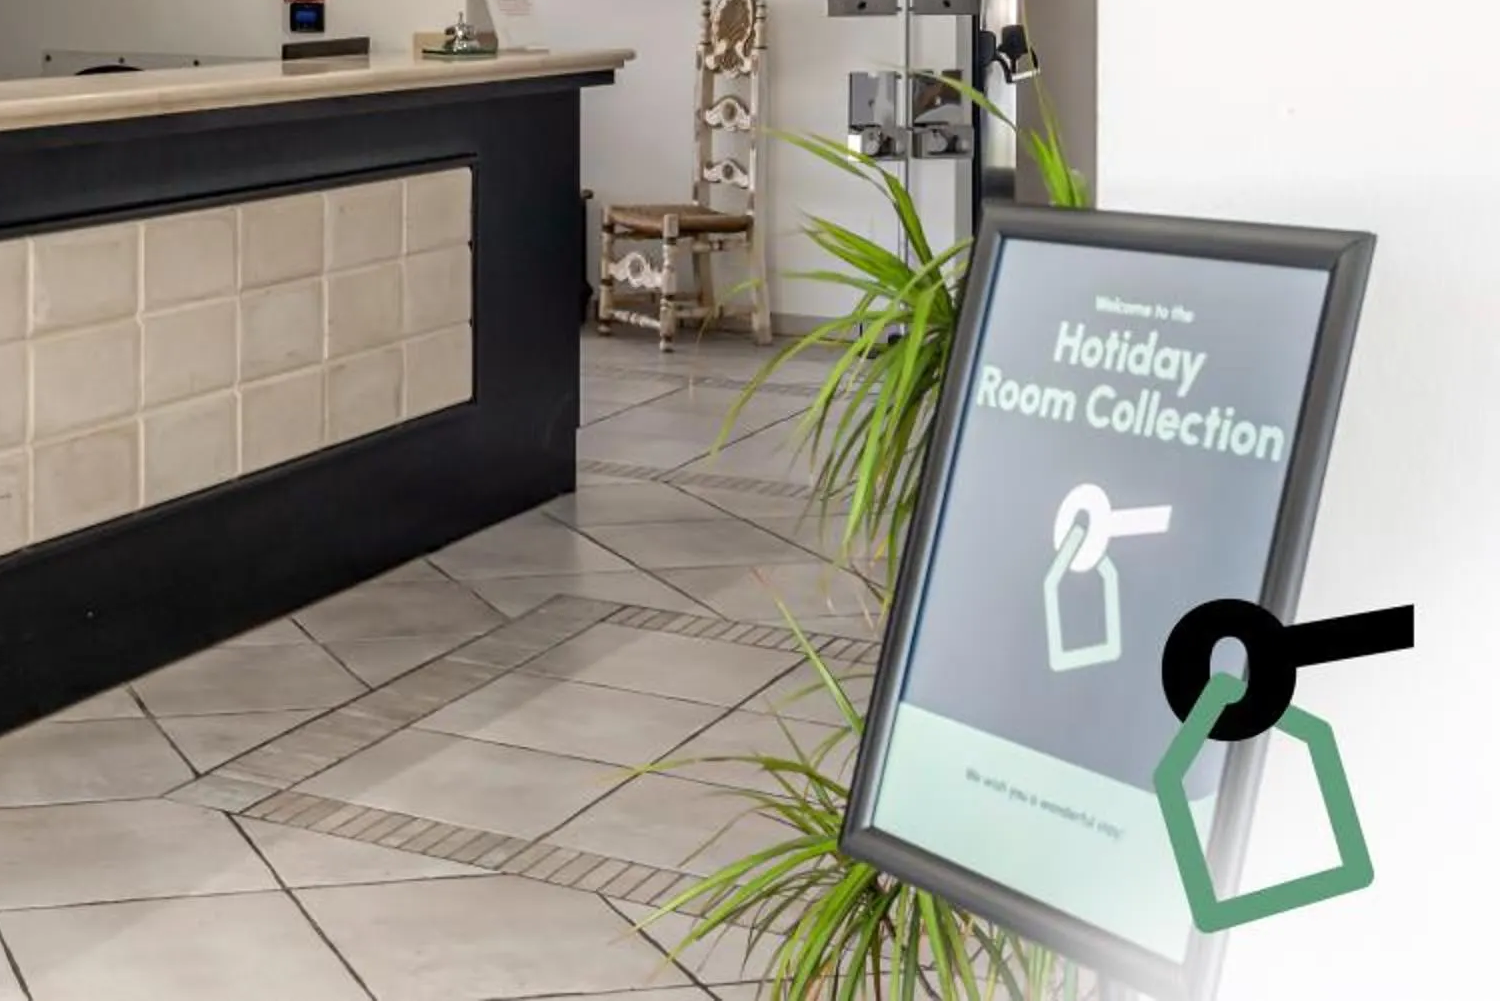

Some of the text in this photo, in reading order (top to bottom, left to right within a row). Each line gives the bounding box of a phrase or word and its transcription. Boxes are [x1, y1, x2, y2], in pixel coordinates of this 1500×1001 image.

[1095, 295, 1195, 323] Welcome to the
[1053, 320, 1207, 397] Hotiday
[976, 364, 1287, 463] Room Collection
